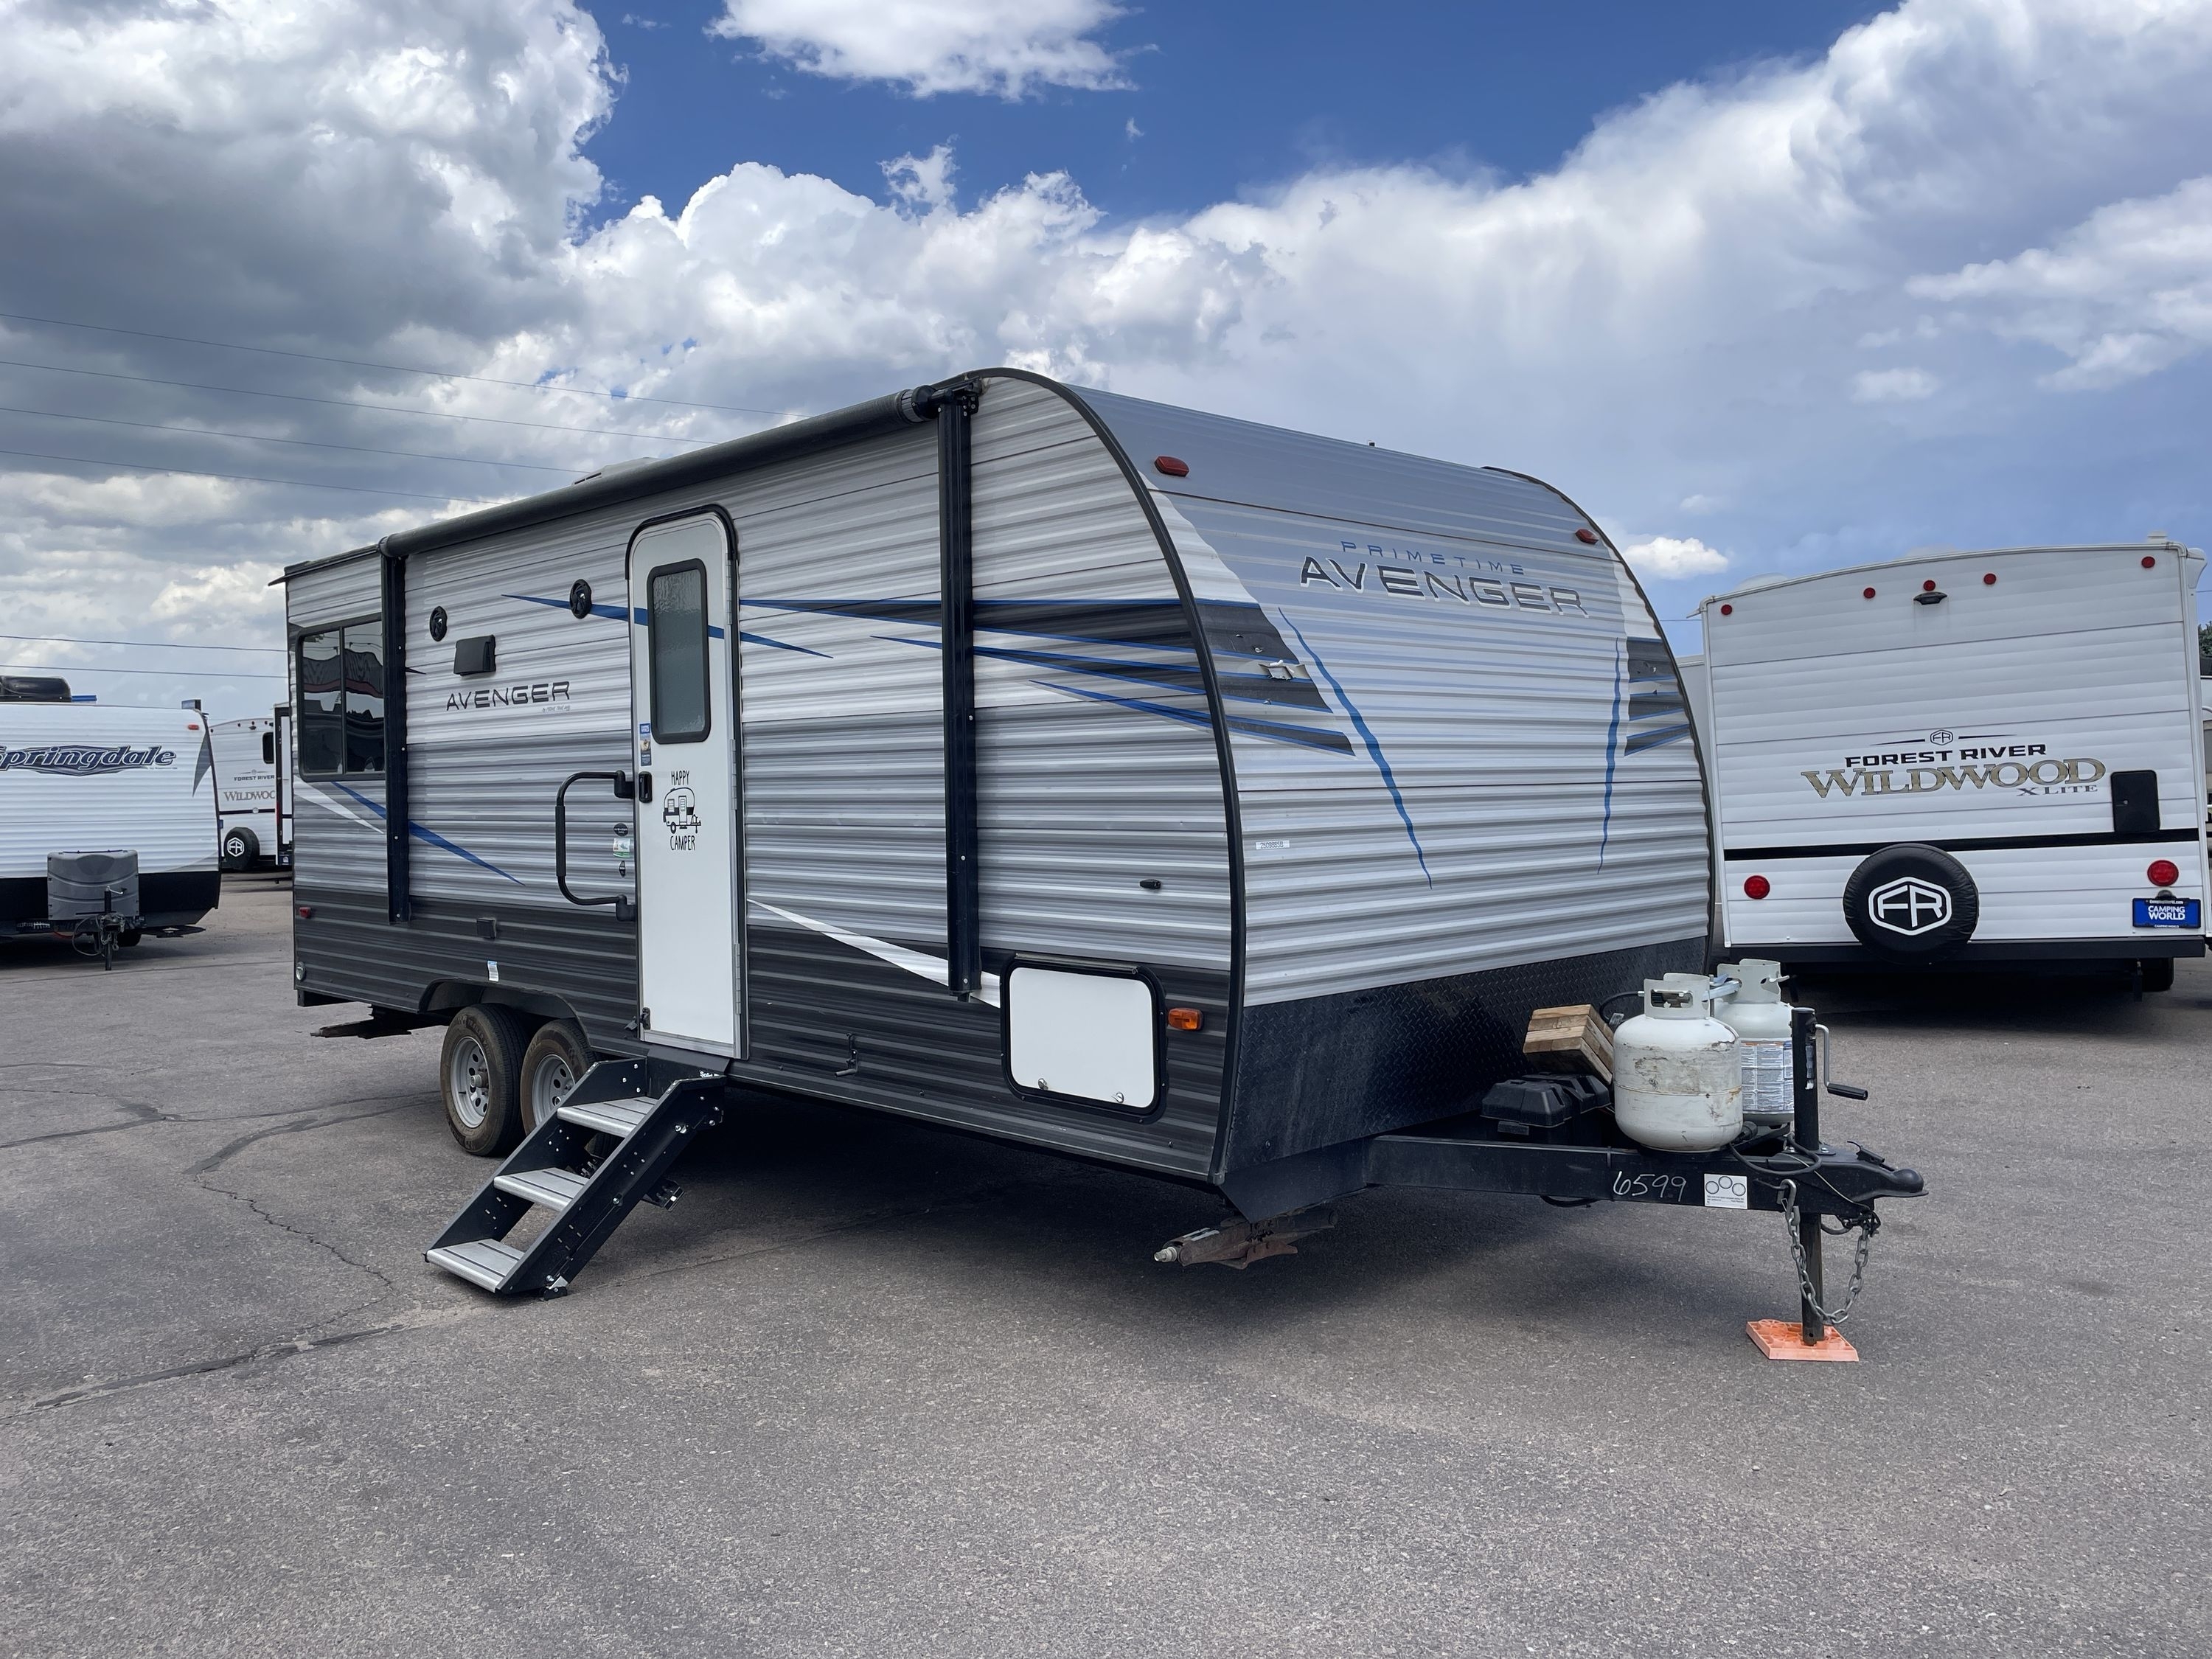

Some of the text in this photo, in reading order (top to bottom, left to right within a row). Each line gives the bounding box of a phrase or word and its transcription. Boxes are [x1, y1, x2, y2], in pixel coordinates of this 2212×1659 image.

[1300, 555, 1590, 619] AVENGER
[446, 681, 570, 712] AVENGER
[1845, 744, 2048, 768] FOREST RIVER
[671, 770, 690, 786] HAPPY
[1801, 757, 2107, 799] WILDWOOD
[669, 835, 695, 851] CAMPER
[2148, 905, 2185, 914] CAMPING
[2148, 912, 2185, 920] WORLD
[1613, 1171, 1687, 1202] 6599
